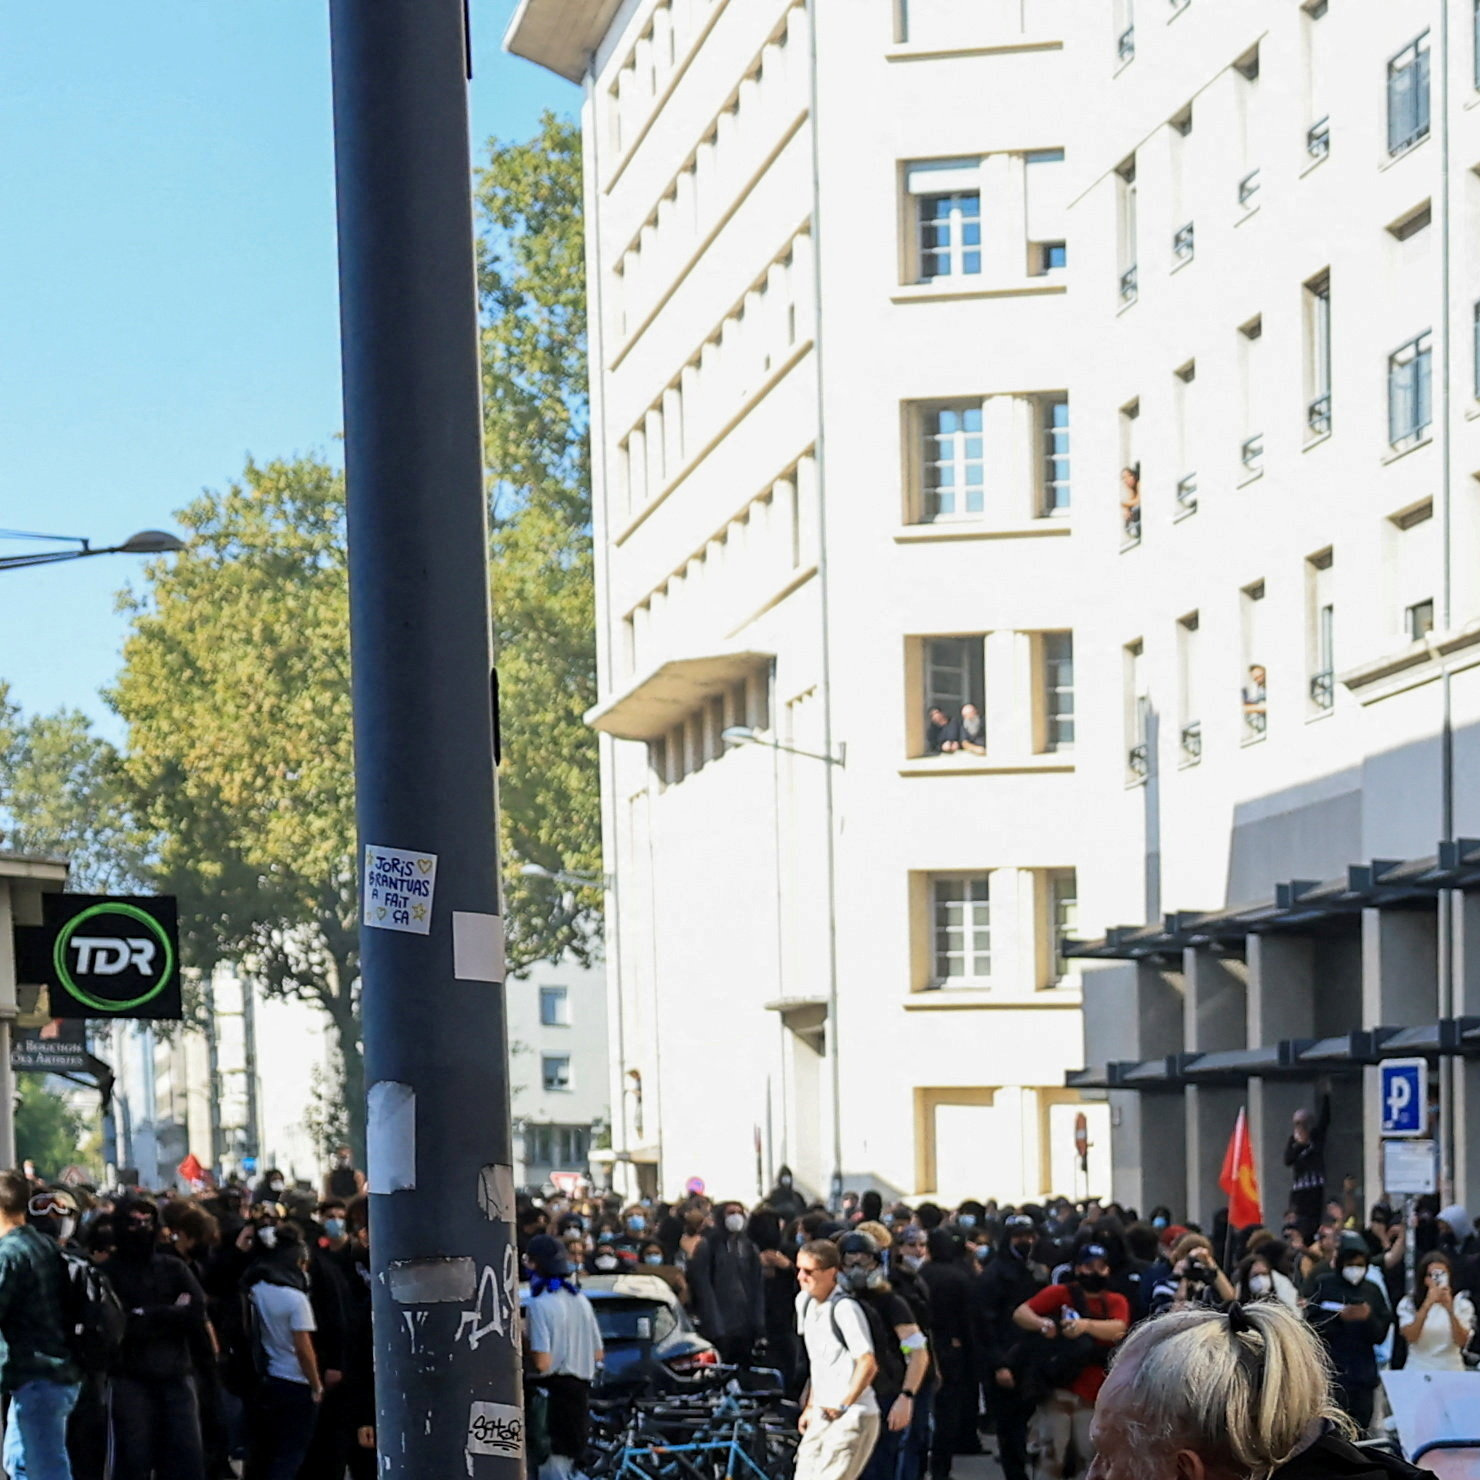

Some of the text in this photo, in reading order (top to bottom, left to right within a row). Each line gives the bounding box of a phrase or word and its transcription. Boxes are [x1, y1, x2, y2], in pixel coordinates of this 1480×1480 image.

[371, 888, 379, 900] A
[70, 936, 156, 976] TDR
[1388, 1076, 1411, 1120] P
